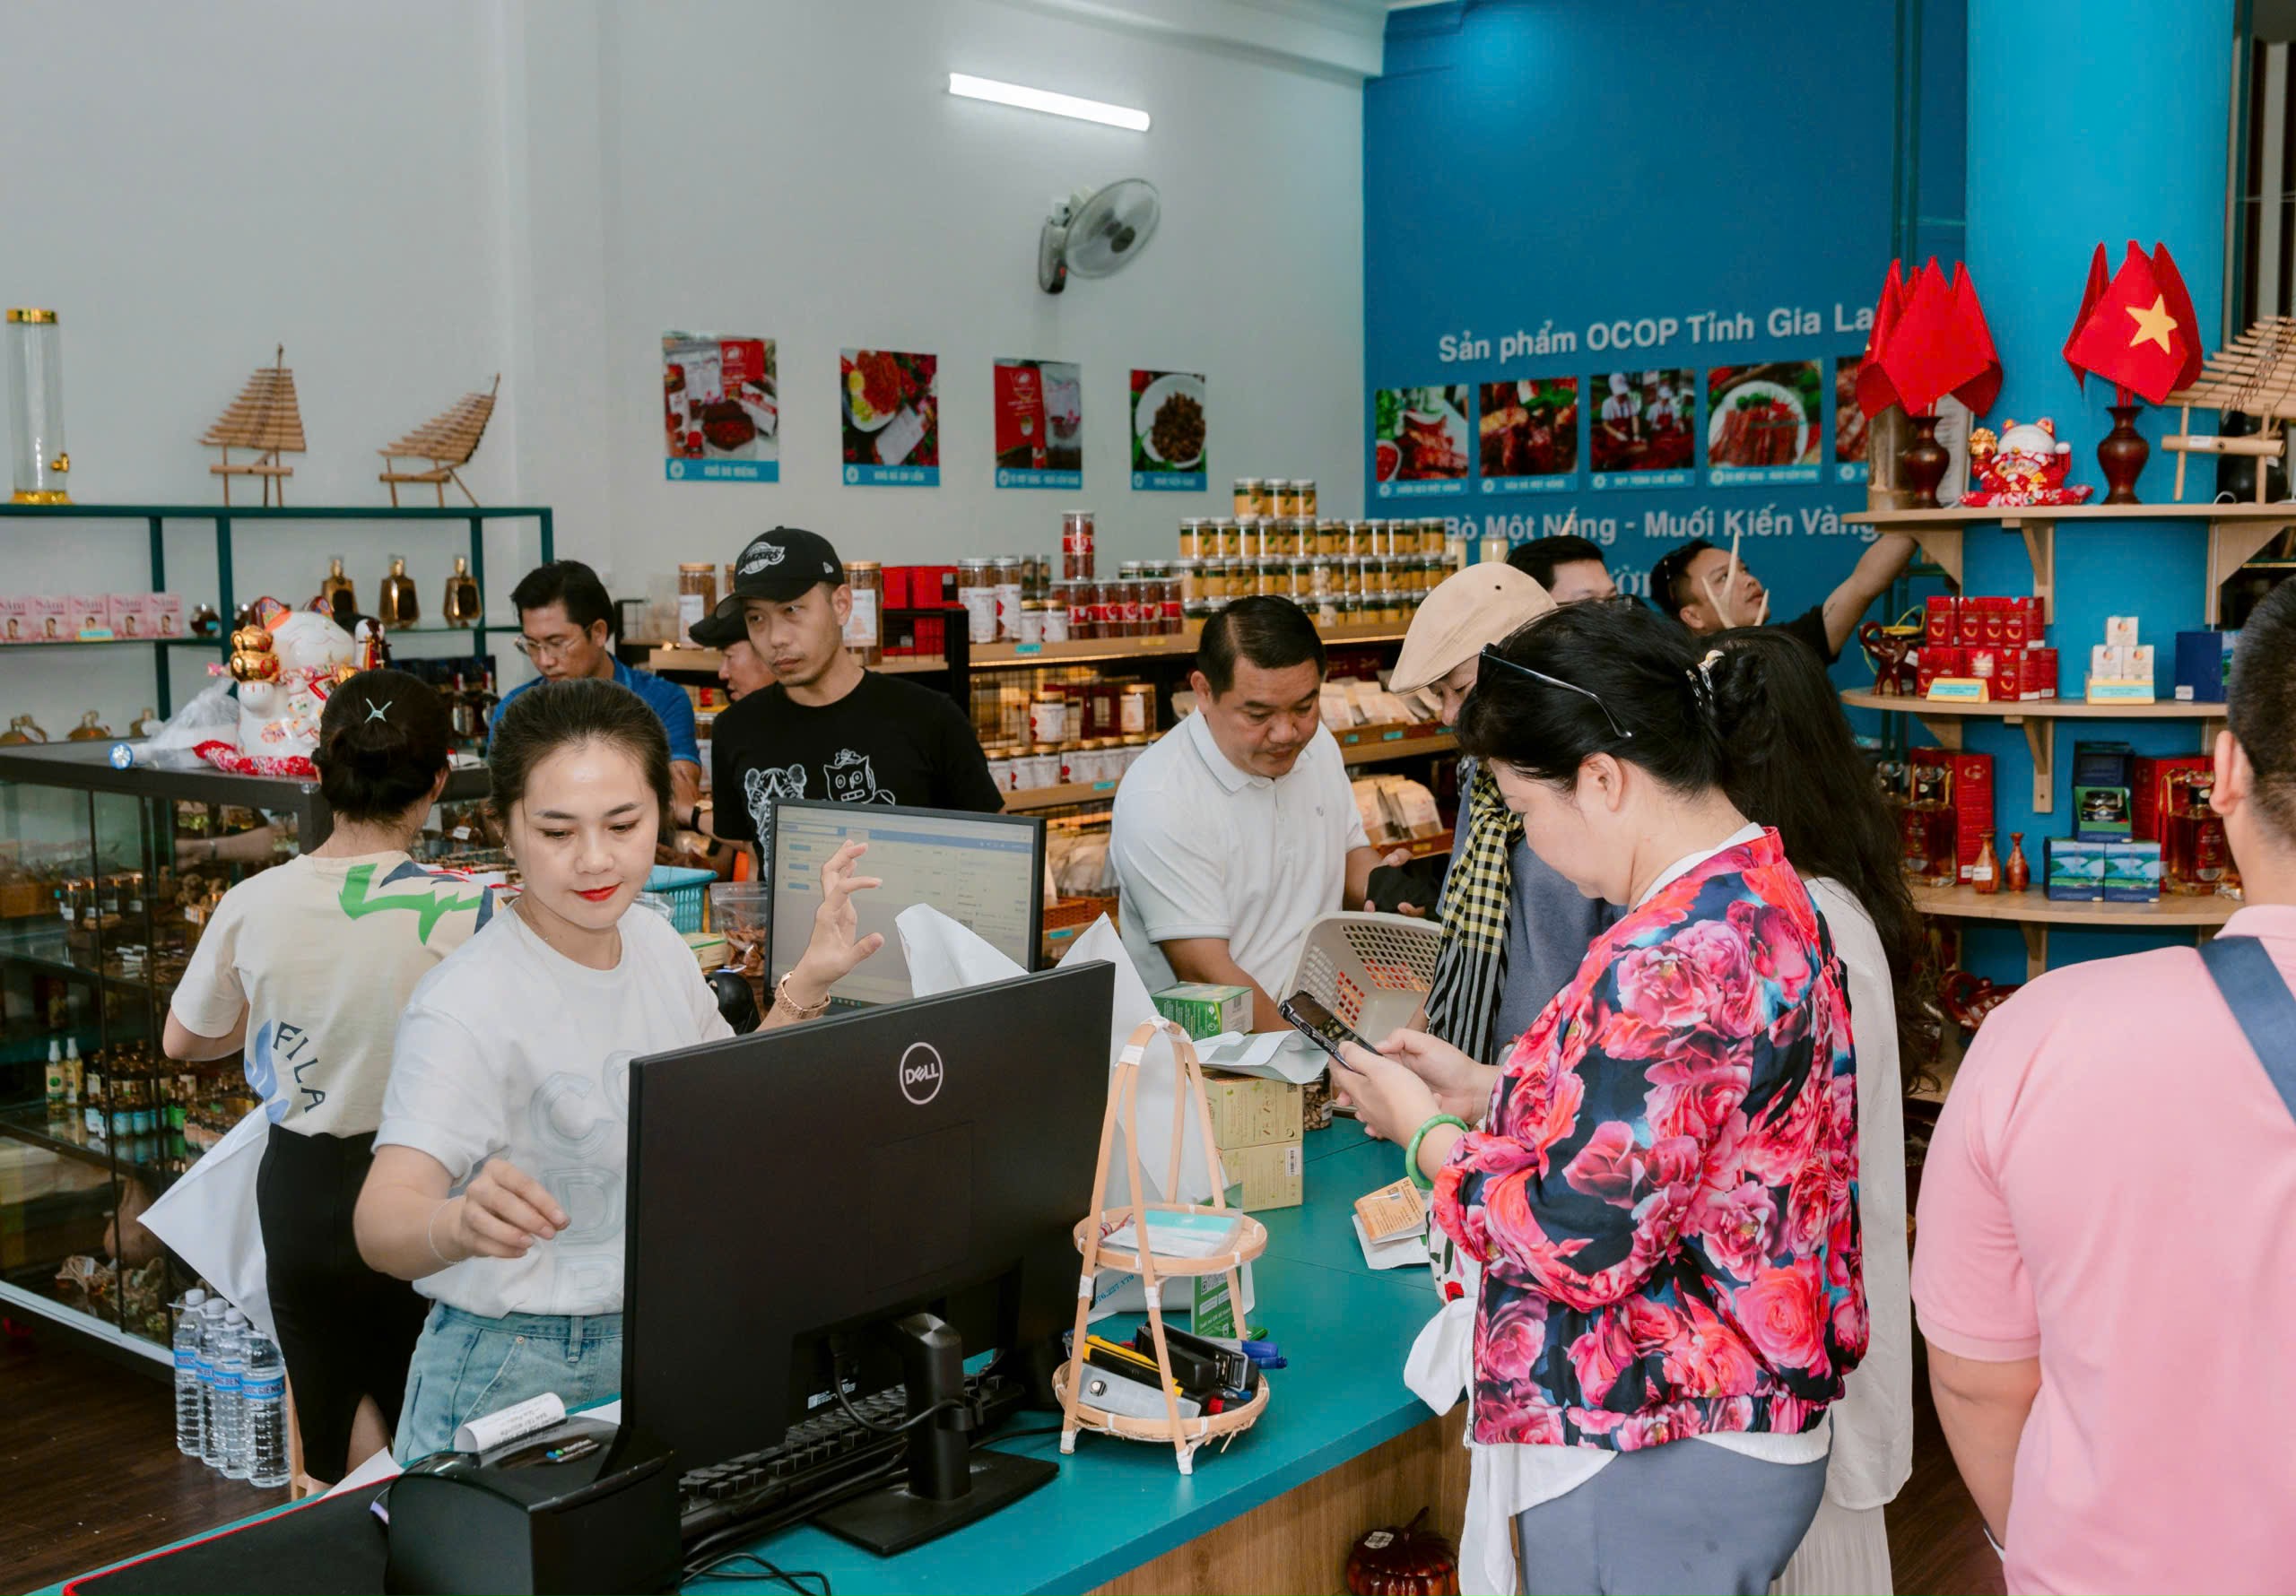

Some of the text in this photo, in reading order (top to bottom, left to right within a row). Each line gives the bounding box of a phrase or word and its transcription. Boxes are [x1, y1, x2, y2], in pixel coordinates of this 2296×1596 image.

[1439, 303, 1874, 365] Sản phẩm OCOP Tỉnh Gia La
[1444, 514, 1478, 541] Bò
[1484, 514, 1535, 547] Một
[1644, 505, 1715, 538] Muối
[1724, 502, 1793, 537] Kiến
[273, 1021, 326, 1113] FILA
[905, 1063, 940, 1085] DELL
